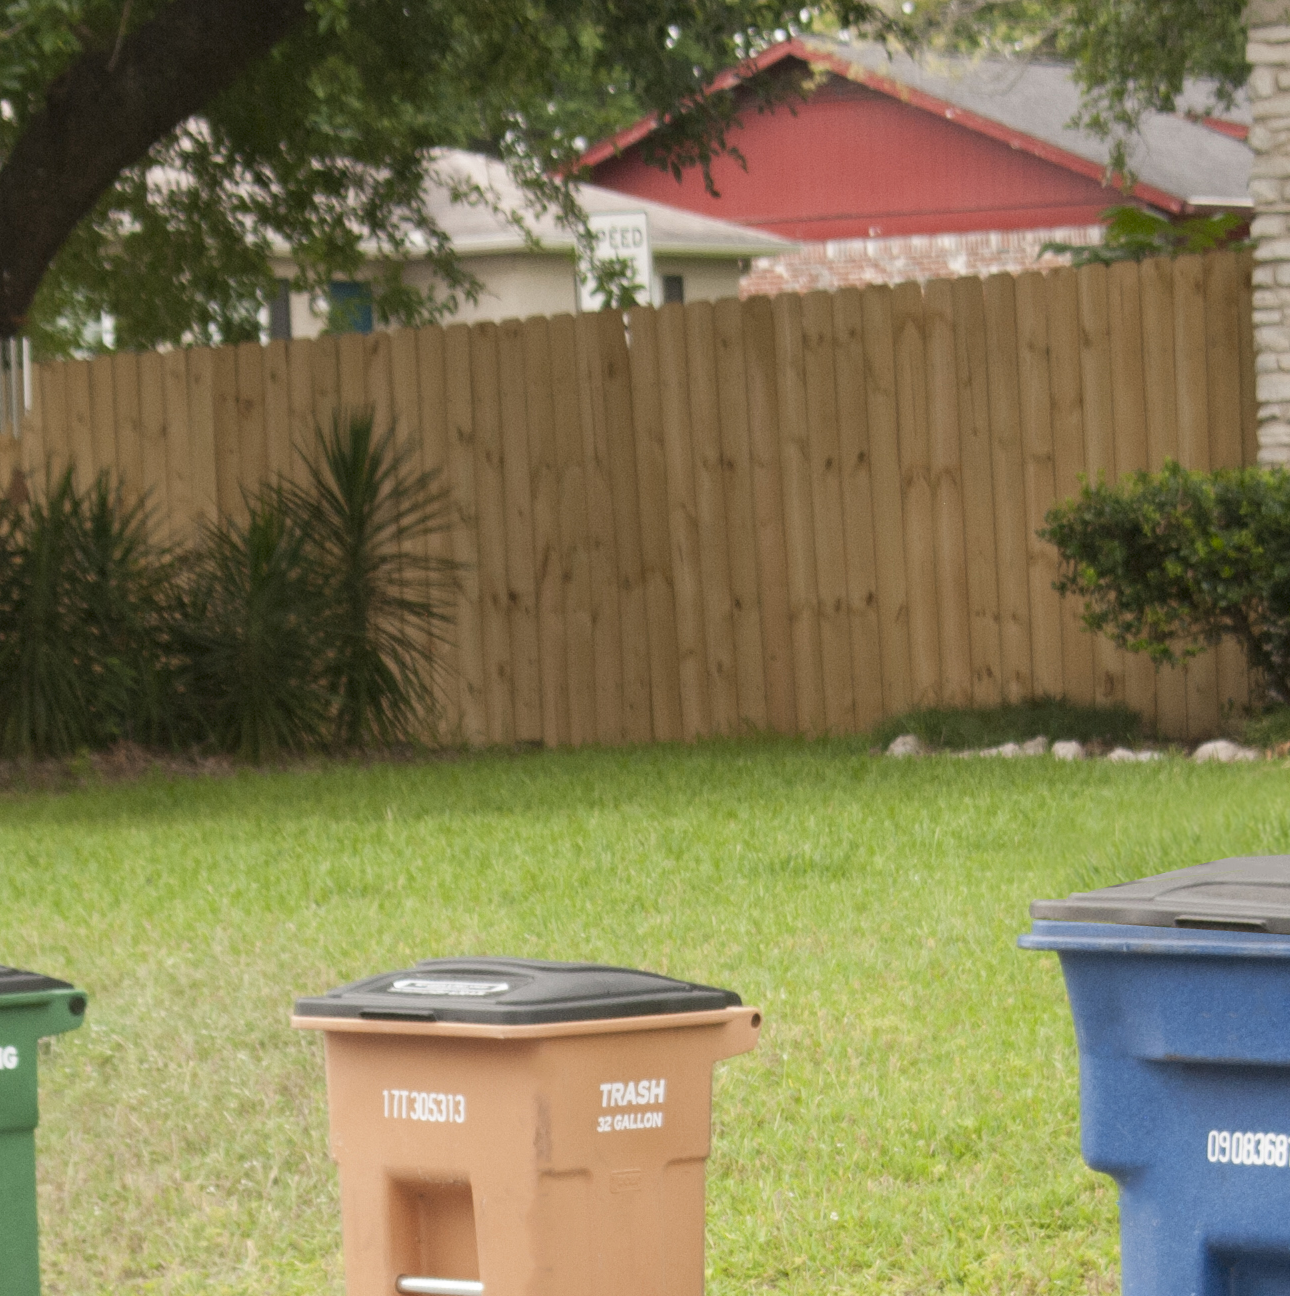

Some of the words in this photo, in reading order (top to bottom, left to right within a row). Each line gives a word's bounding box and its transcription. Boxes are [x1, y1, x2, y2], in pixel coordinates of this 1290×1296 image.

[588, 227, 643, 249] PEED
[599, 1078, 666, 1108] TRASH
[382, 1089, 466, 1124] 17T305313
[596, 1115, 613, 1133] 32
[613, 1111, 664, 1131] GALLON
